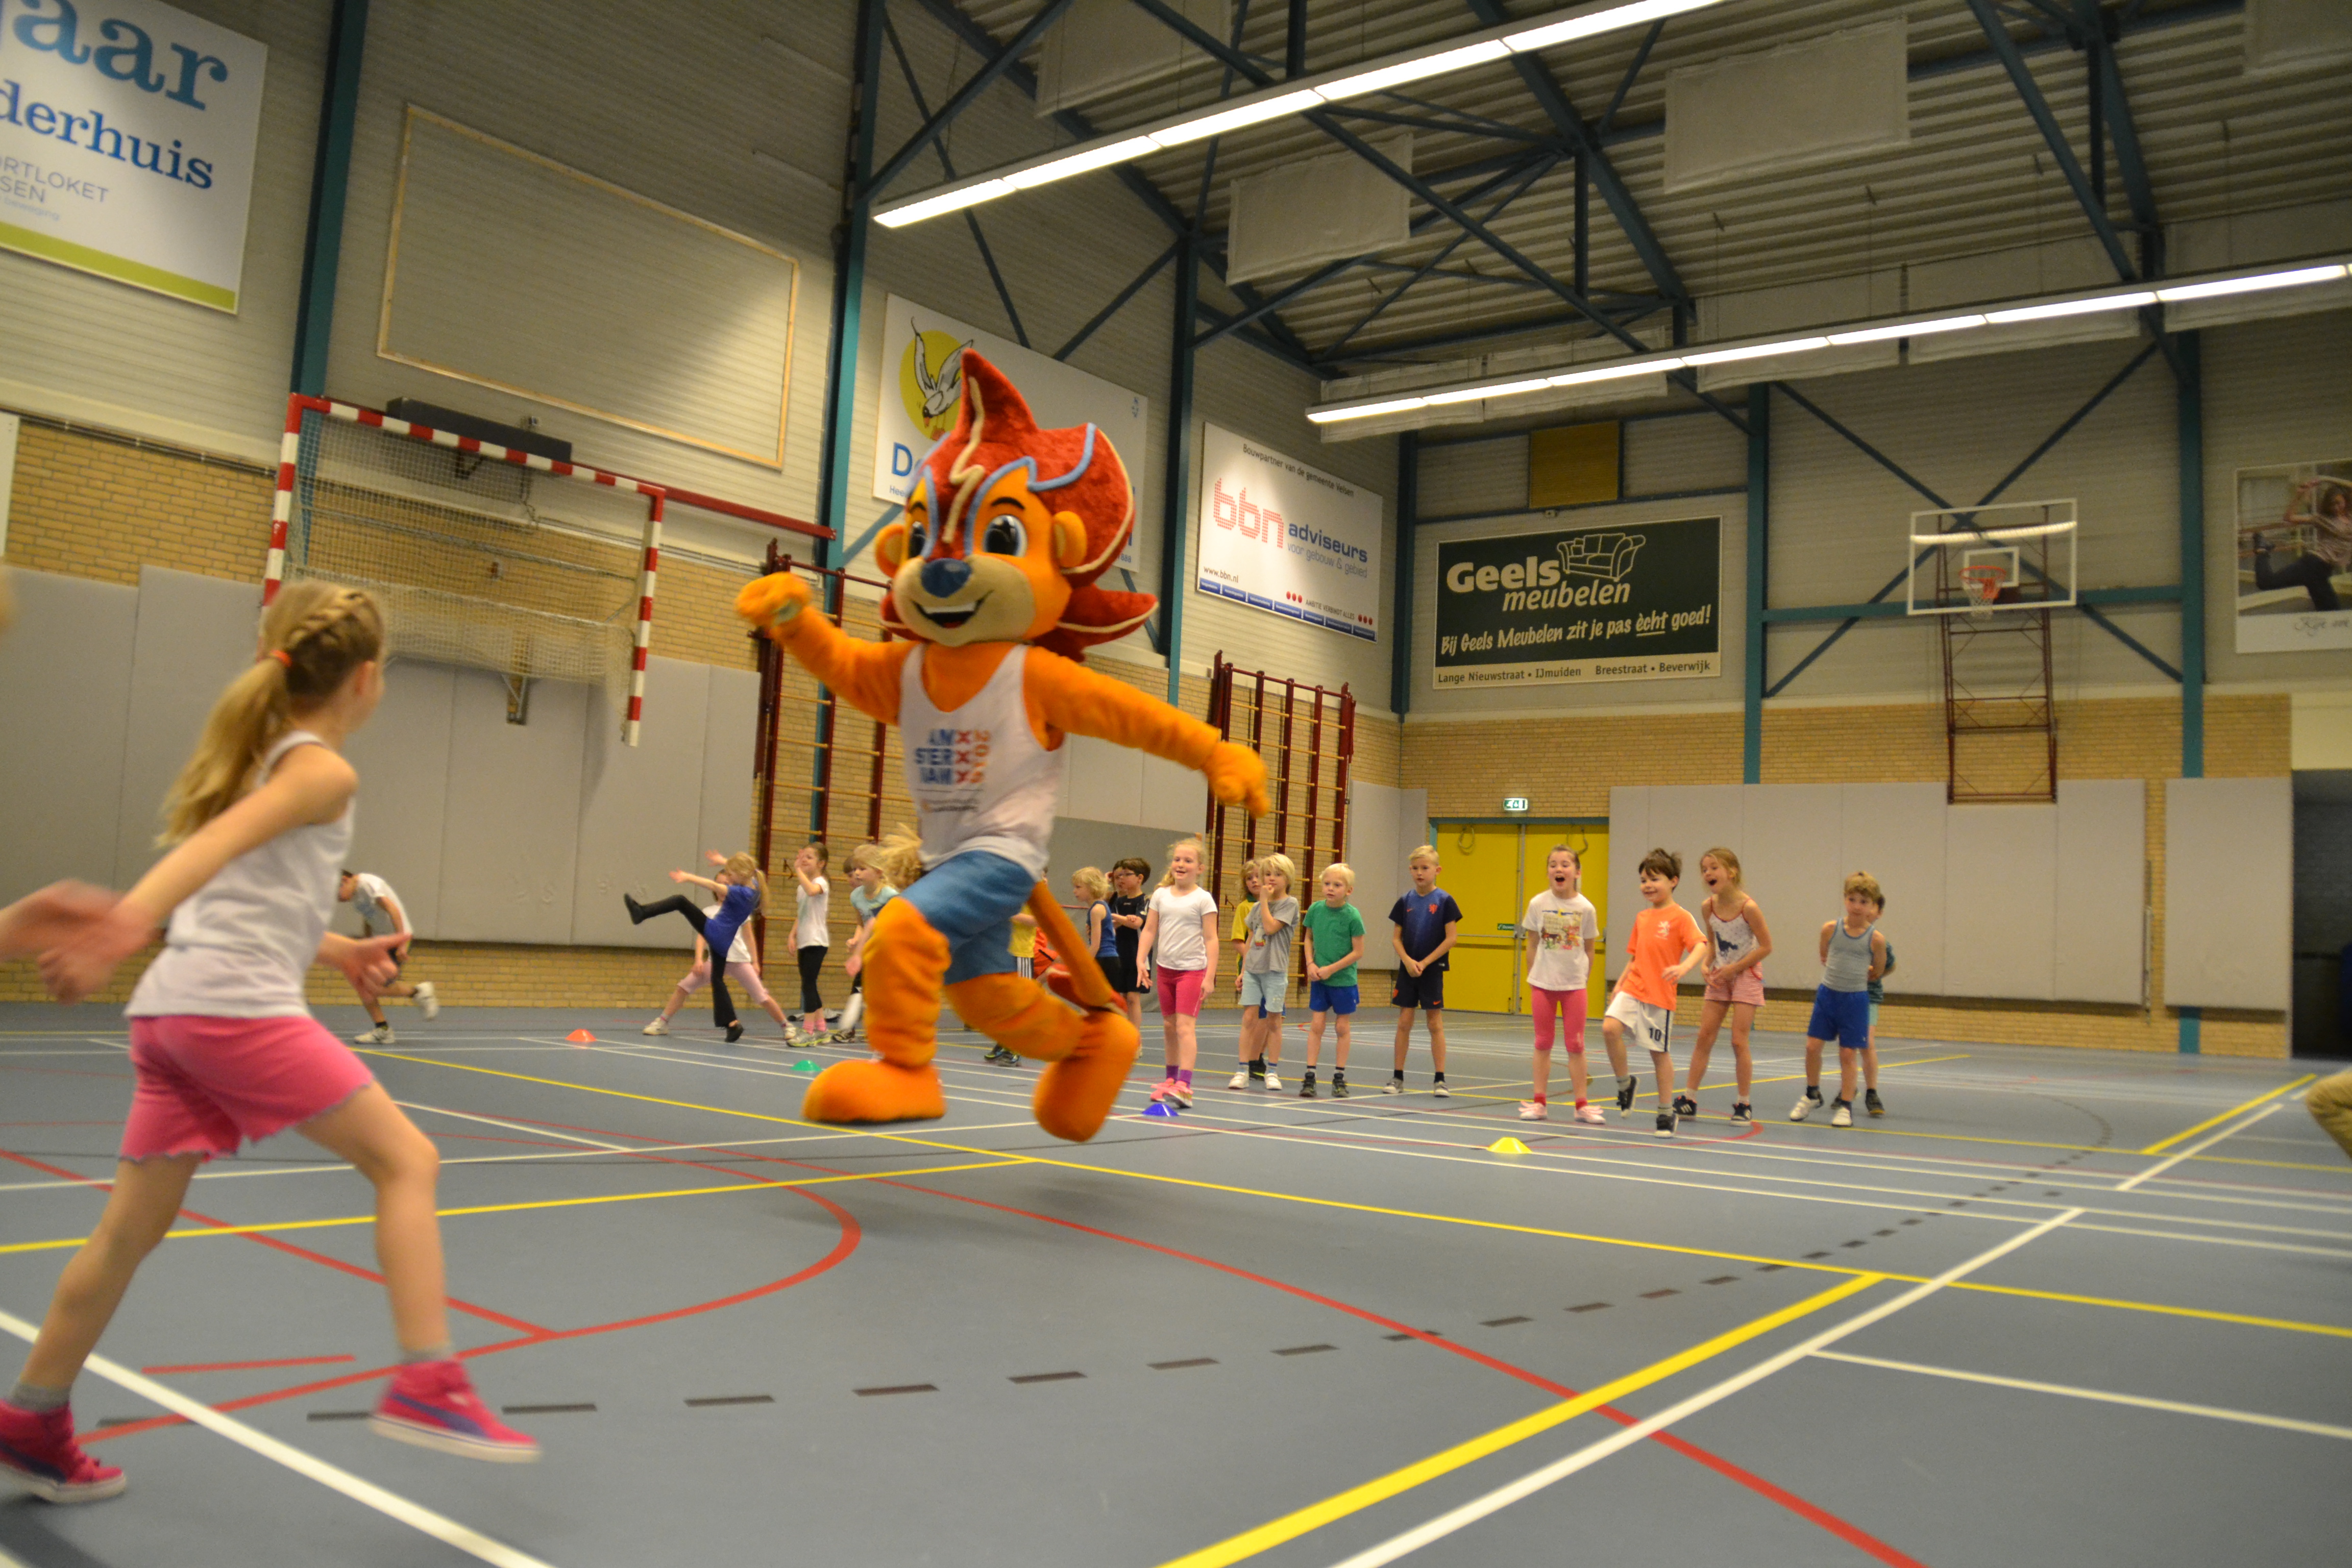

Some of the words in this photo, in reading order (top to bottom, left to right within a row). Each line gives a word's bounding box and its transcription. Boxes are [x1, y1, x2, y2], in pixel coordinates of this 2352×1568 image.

[0, 0, 228, 111] aar
[0, 157, 109, 202] RTLOKET
[891, 442, 920, 476] D
[1243, 444, 1283, 468] Bouwpartner
[1285, 463, 1295, 473] van
[1297, 467, 1305, 476] de
[1306, 472, 1334, 489] gemeente
[1336, 482, 1354, 497] Velsen
[1213, 478, 1284, 548] bbn
[1289, 523, 1367, 562] adviseurs
[1204, 566, 1238, 583] www.bbn.nl
[1288, 543, 1304, 554] voor
[1306, 549, 1334, 567] gebouw
[1336, 557, 1342, 569] &
[1345, 563, 1367, 578] gebied
[1447, 556, 1560, 593] Geels
[1306, 599, 1322, 609] AMBITIE
[1343, 611, 1355, 620] ALLES
[1502, 579, 1630, 611] meubelen
[1441, 635, 1458, 656] Bij
[1461, 630, 1493, 652] Geels
[1498, 623, 1562, 648] Meubelen
[1566, 620, 1588, 640] zit
[1589, 619, 1603, 641] je
[1606, 619, 1632, 640] pas
[1671, 604, 1711, 631] goed!
[1438, 674, 1465, 684] Lange
[1468, 670, 1525, 681] Nieuwstraat
[1535, 667, 1581, 678] IJmuiden
[1596, 664, 1648, 675] Breestraat
[1659, 660, 1711, 673] Beverwijk
[1649, 1027, 1662, 1042] 10
